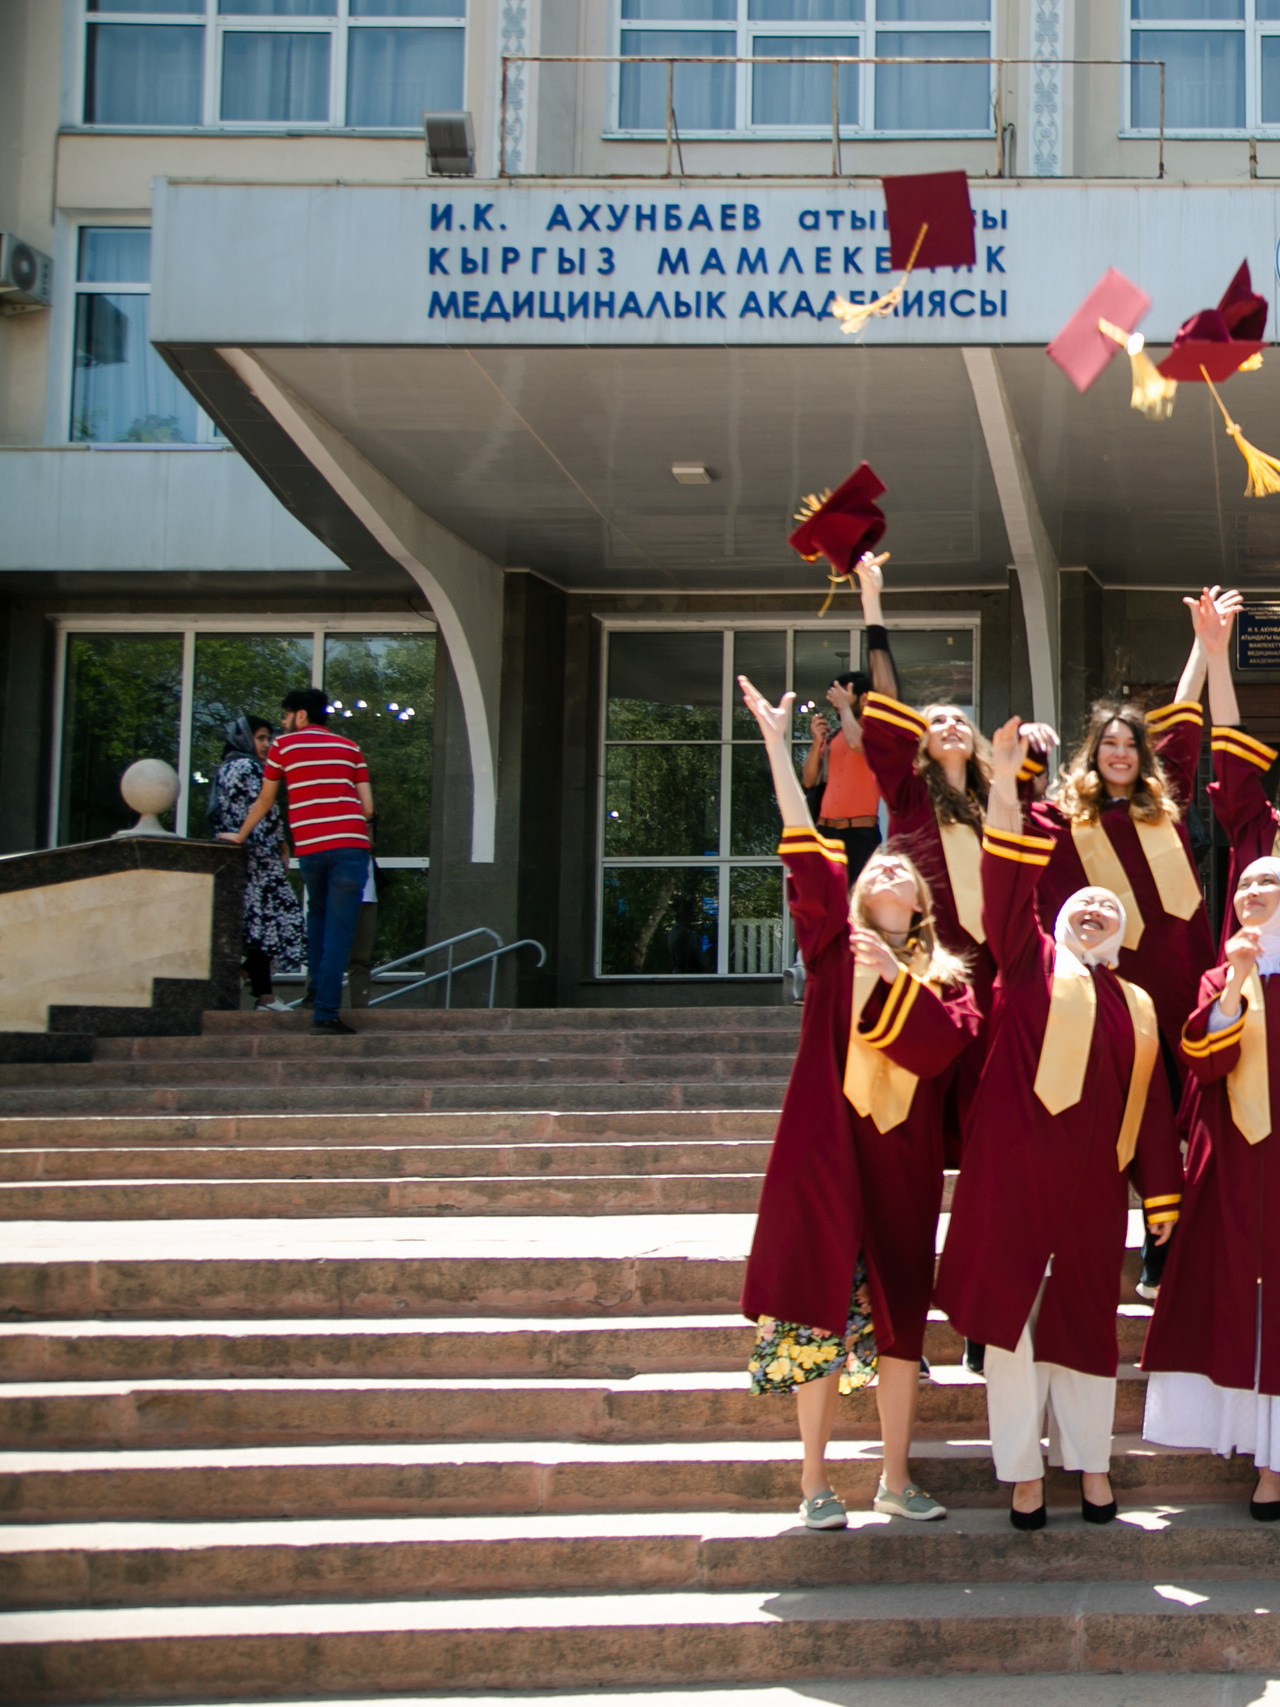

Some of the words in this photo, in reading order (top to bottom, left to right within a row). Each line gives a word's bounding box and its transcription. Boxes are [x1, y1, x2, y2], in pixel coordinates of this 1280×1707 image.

[430, 203, 507, 231] И.К.
[546, 203, 761, 231] АХУНБАЕВ
[428, 246, 615, 275] КЫРГЫЗ
[657, 245, 1006, 274] МАМЛЕКЕК
[427, 290, 726, 322] МЕДИЦИНАЛЫК
